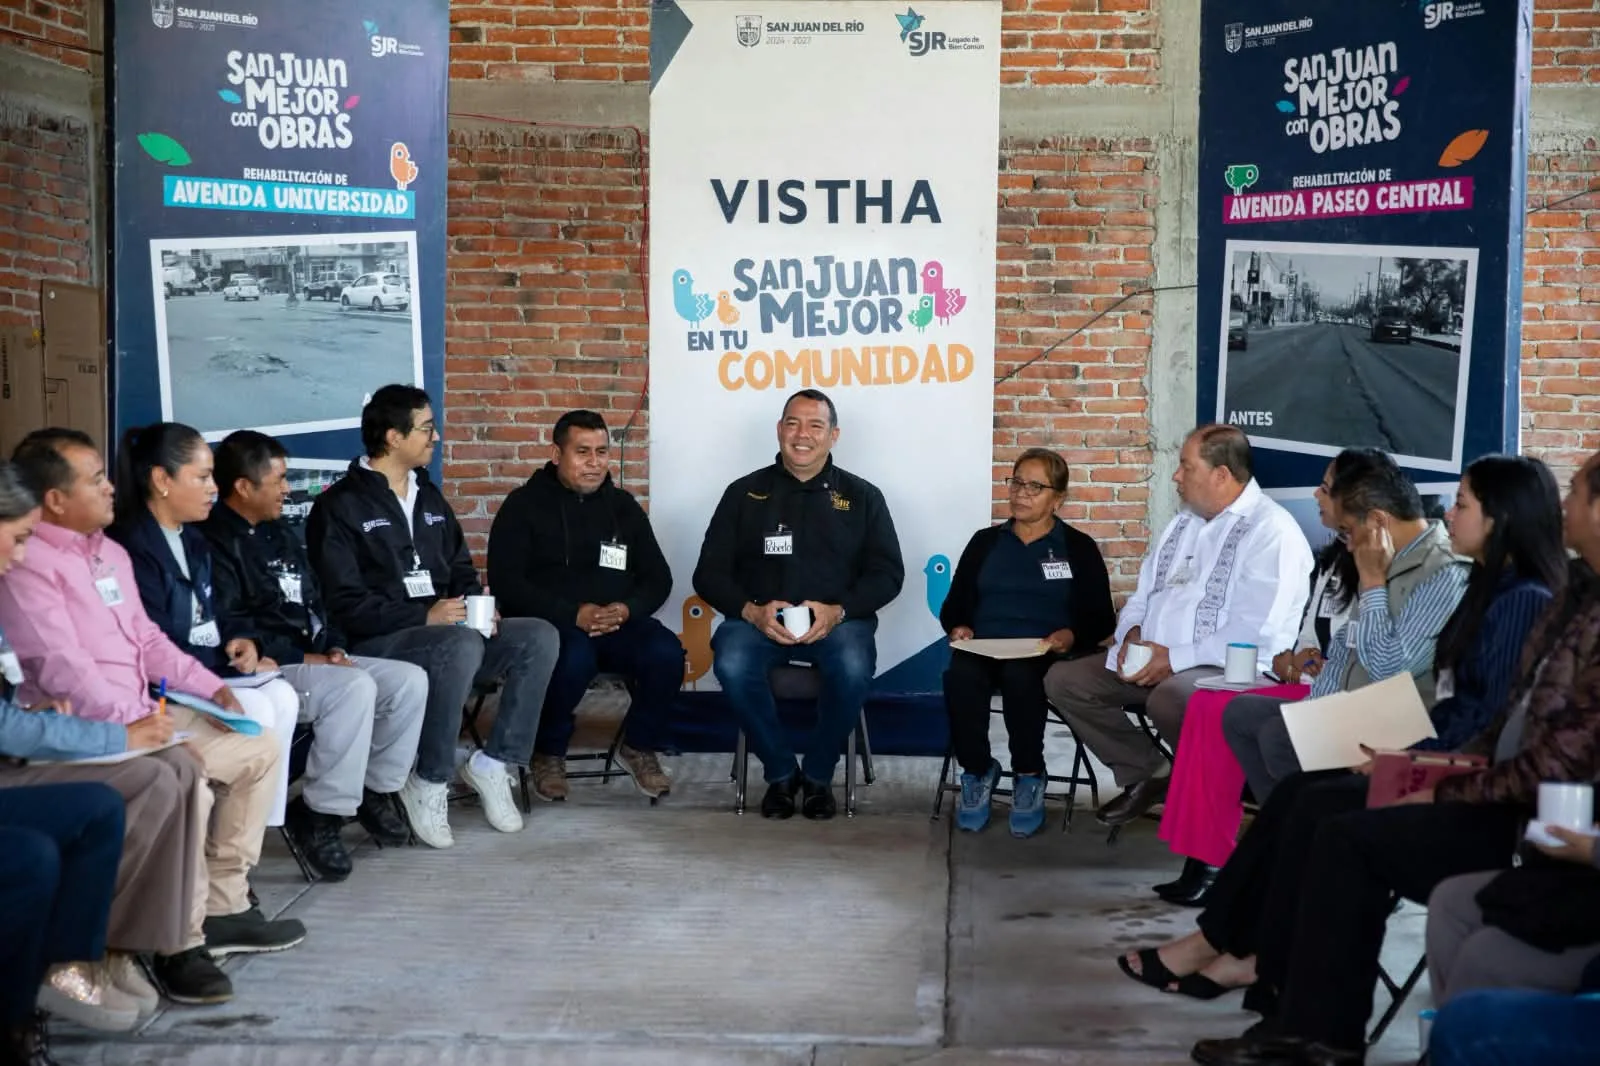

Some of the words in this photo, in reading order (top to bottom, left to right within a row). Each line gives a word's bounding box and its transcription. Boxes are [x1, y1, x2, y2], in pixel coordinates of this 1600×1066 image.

[177, 7, 197, 18] SAN
[199, 9, 223, 21] JUAN
[224, 13, 241, 23] DEL
[766, 22, 790, 32] SAN
[791, 22, 820, 32] JUAN
[822, 22, 844, 32] DEL
[845, 19, 865, 32] RÍO
[1245, 26, 1261, 37] SAN
[1262, 24, 1282, 35] JUAN
[1283, 21, 1298, 31] DEL
[1299, 16, 1313, 29] RÍO
[1424, 2, 1454, 29] SJR
[371, 35, 397, 57] SJR
[908, 32, 947, 56] SJR
[245, 78, 339, 115] MEJOR
[1299, 75, 1388, 118] MEJOR
[231, 110, 258, 127] con
[258, 113, 353, 149] OBRAS
[1286, 117, 1308, 136] con
[1309, 100, 1401, 154] OBRAS
[243, 167, 332, 185] REHABILITACIÓN
[335, 173, 348, 185] DE
[1293, 168, 1376, 188] REHABILITACIÓN
[1378, 168, 1392, 181] DE
[172, 180, 268, 208] AVENIDA
[274, 187, 408, 215] UNIVERSIDAD
[709, 178, 942, 224] VISTHA
[1229, 190, 1306, 220] AVENIDA
[1312, 185, 1369, 215] PASEO
[1376, 180, 1465, 210] CENTRAL
[760, 291, 904, 338] MEJOR
[687, 330, 714, 351] EN
[720, 329, 748, 350] TU
[718, 343, 975, 391] COMUNIDAD
[1228, 411, 1273, 427] ANTES
